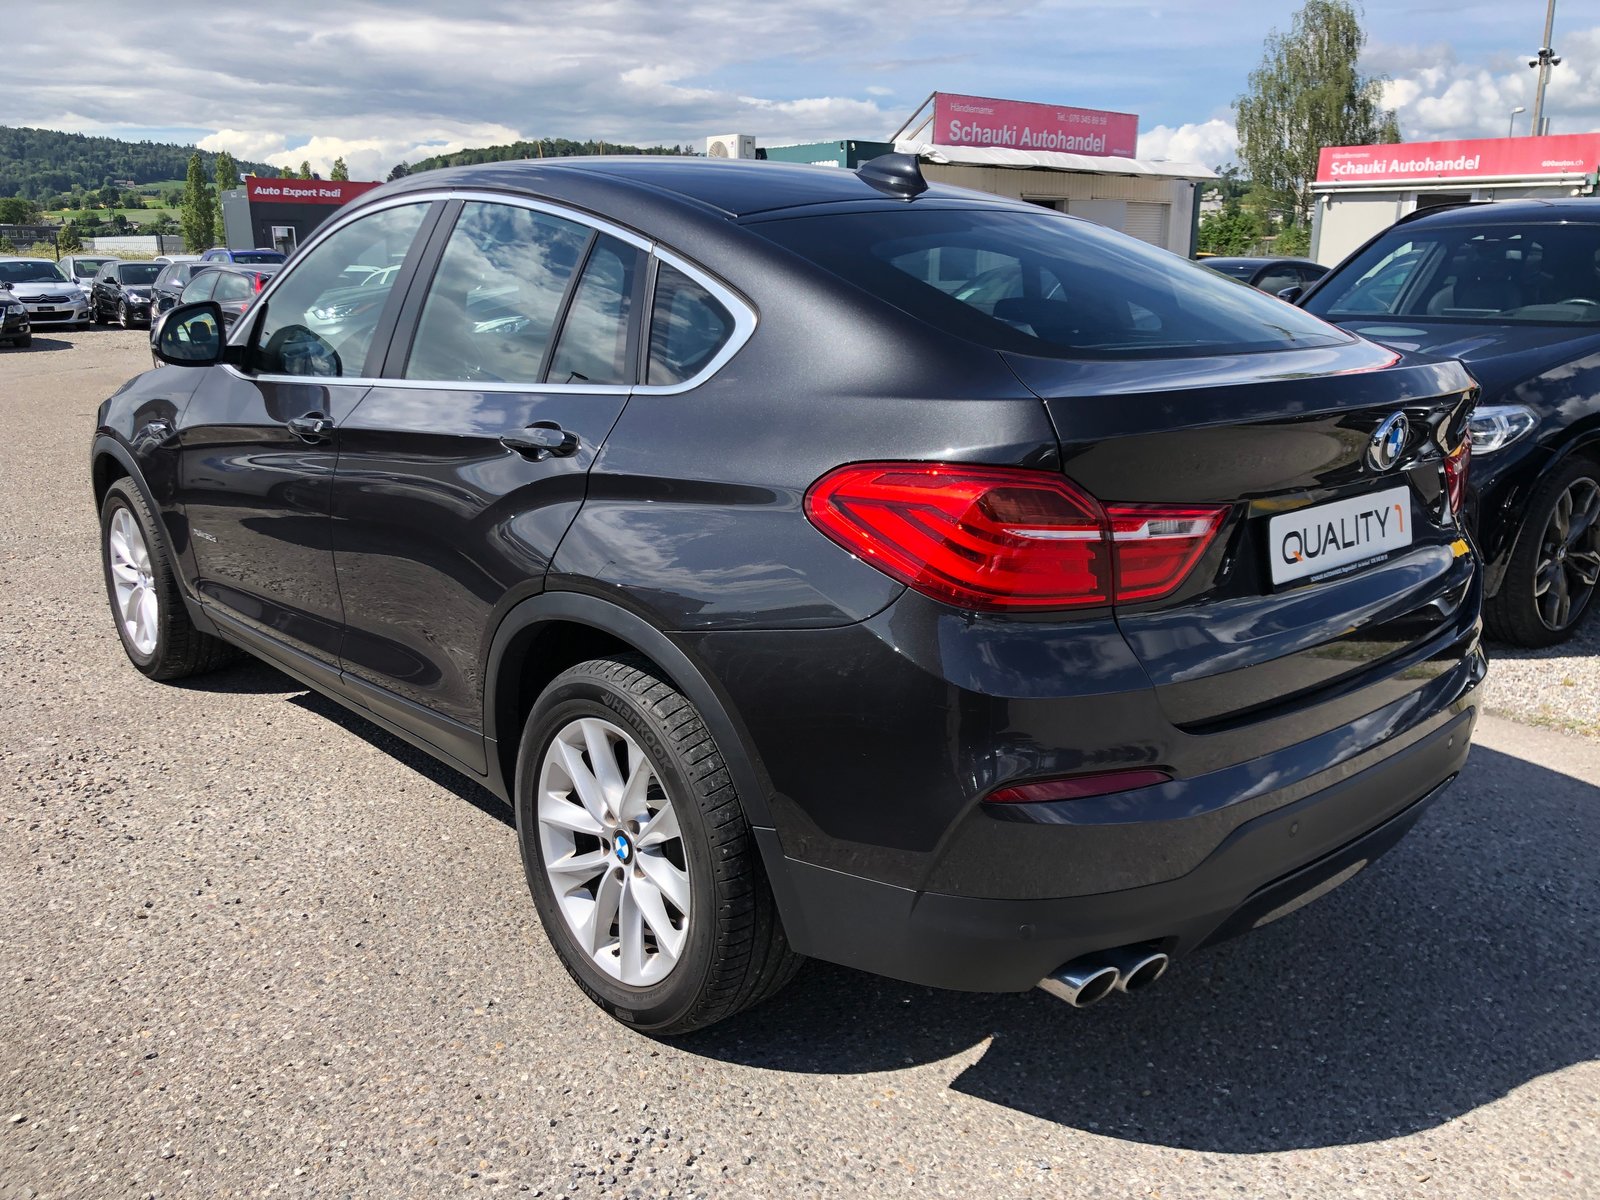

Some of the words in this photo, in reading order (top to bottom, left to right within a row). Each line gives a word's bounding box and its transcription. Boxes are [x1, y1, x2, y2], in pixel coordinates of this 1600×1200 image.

[949, 119, 1017, 145] Schauki
[1019, 126, 1107, 153] Autohandel
[1330, 158, 1388, 177] Schauki
[1389, 154, 1481, 174] Autohandel
[254, 186, 281, 196] Auto
[282, 187, 318, 198] Export
[319, 188, 342, 198] Fadi
